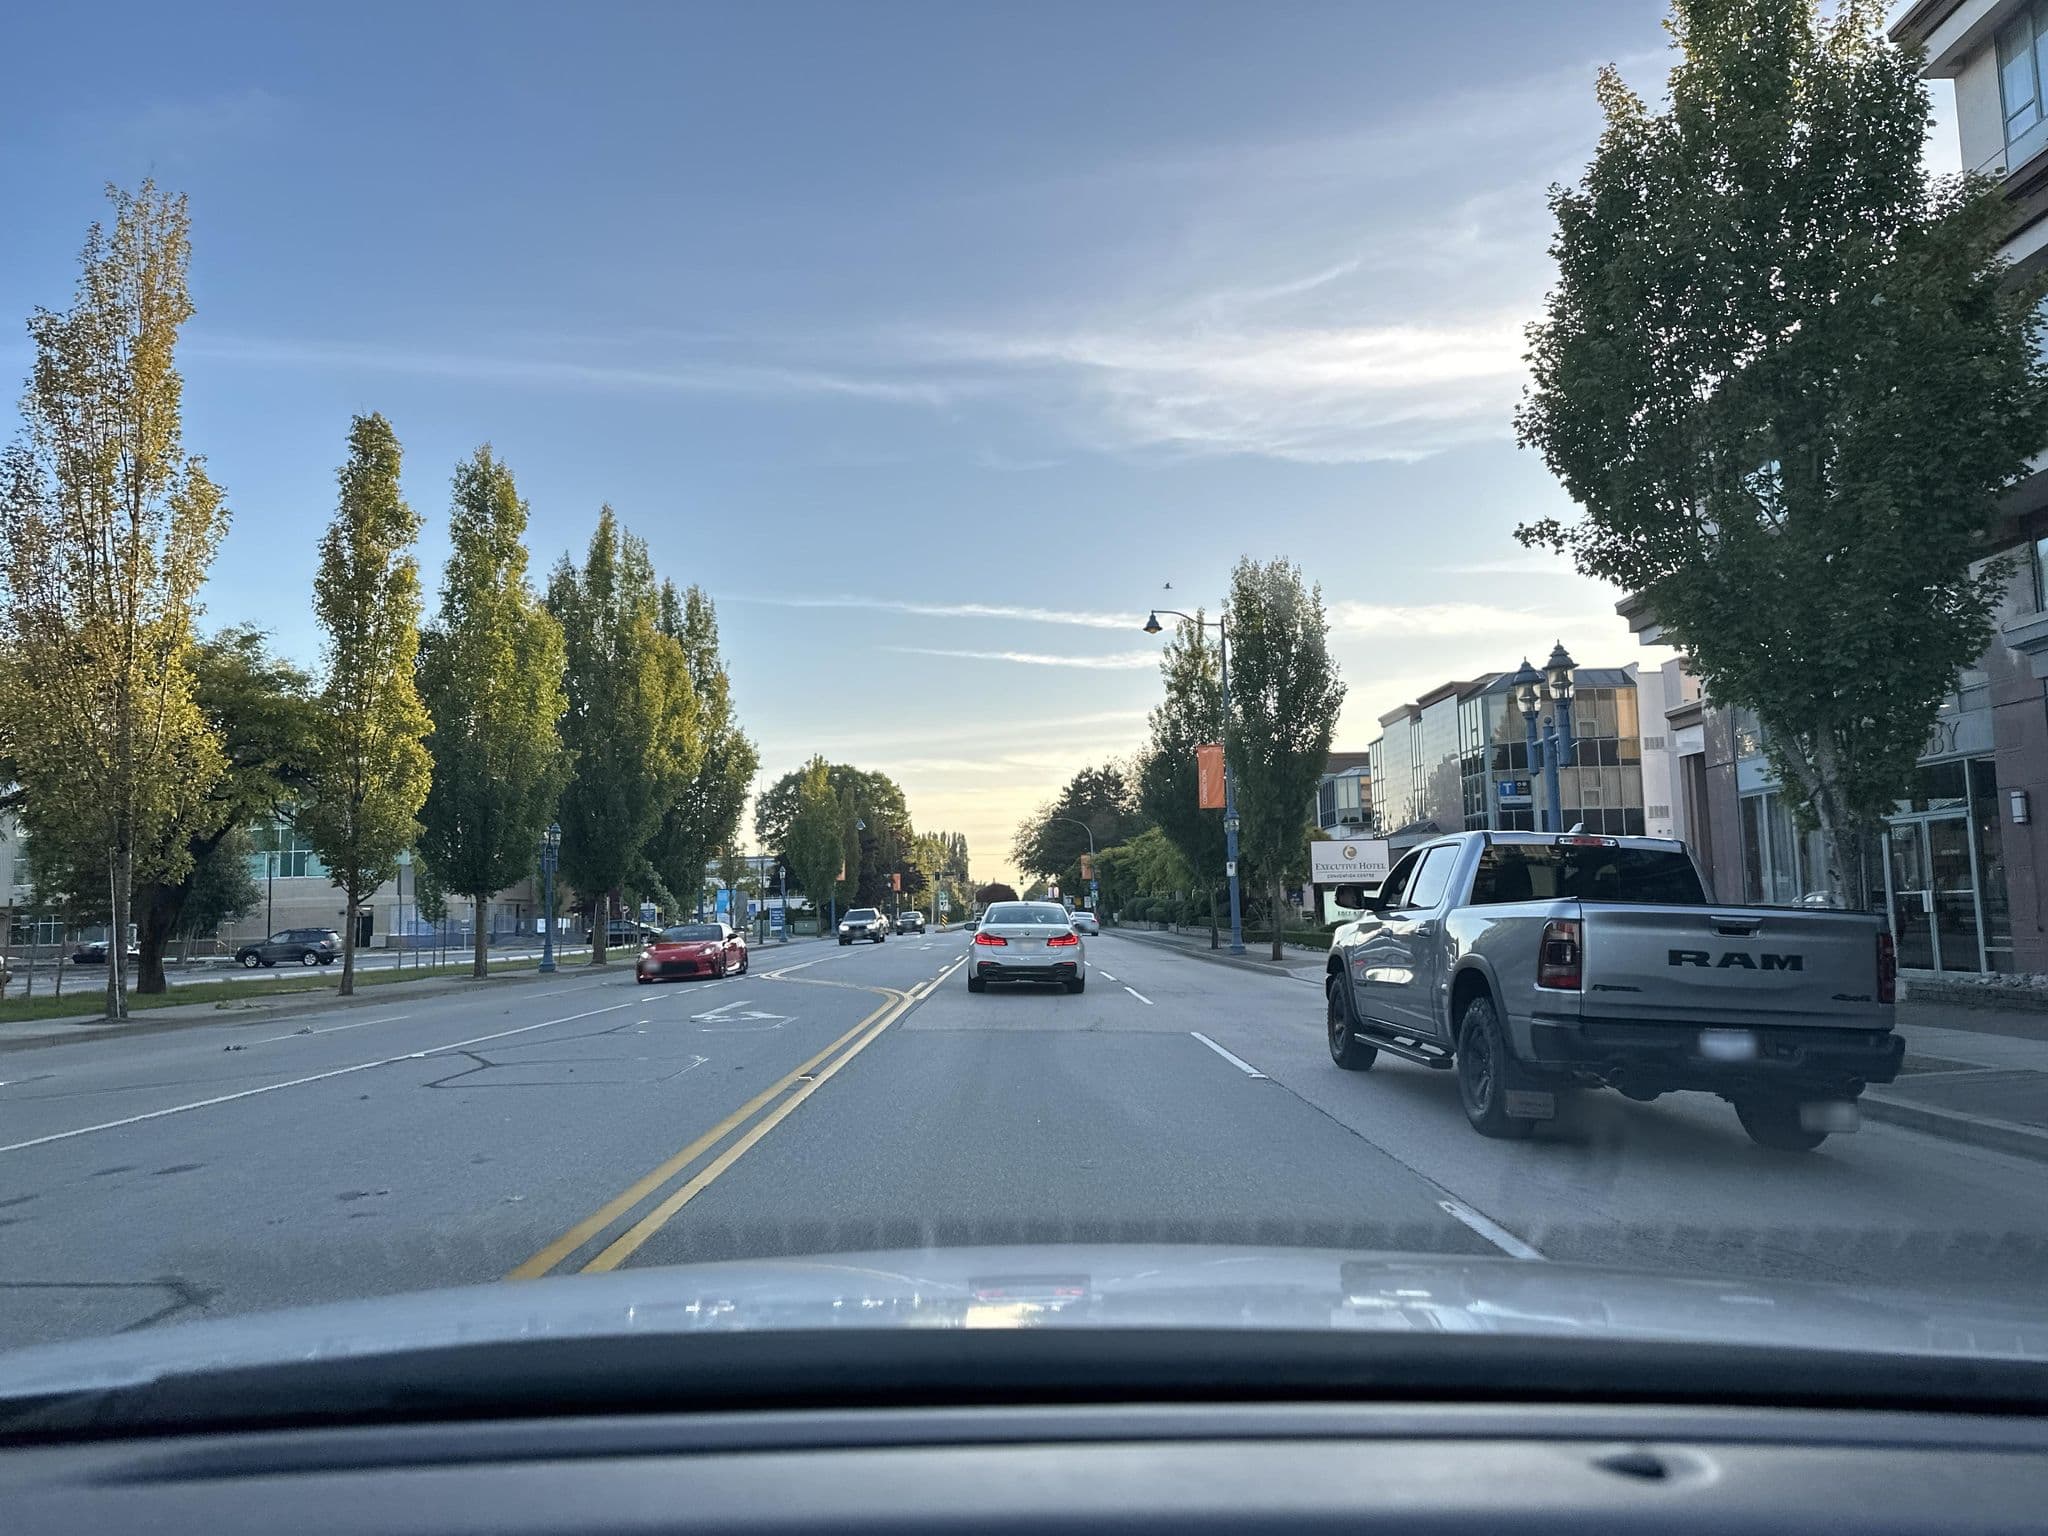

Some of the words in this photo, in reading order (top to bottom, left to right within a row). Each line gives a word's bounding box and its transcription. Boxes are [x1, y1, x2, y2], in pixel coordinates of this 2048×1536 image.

[1315, 863, 1357, 871] EXECUTIVE
[1359, 862, 1386, 870] HOTEL
[1668, 949, 1804, 971] RAM
